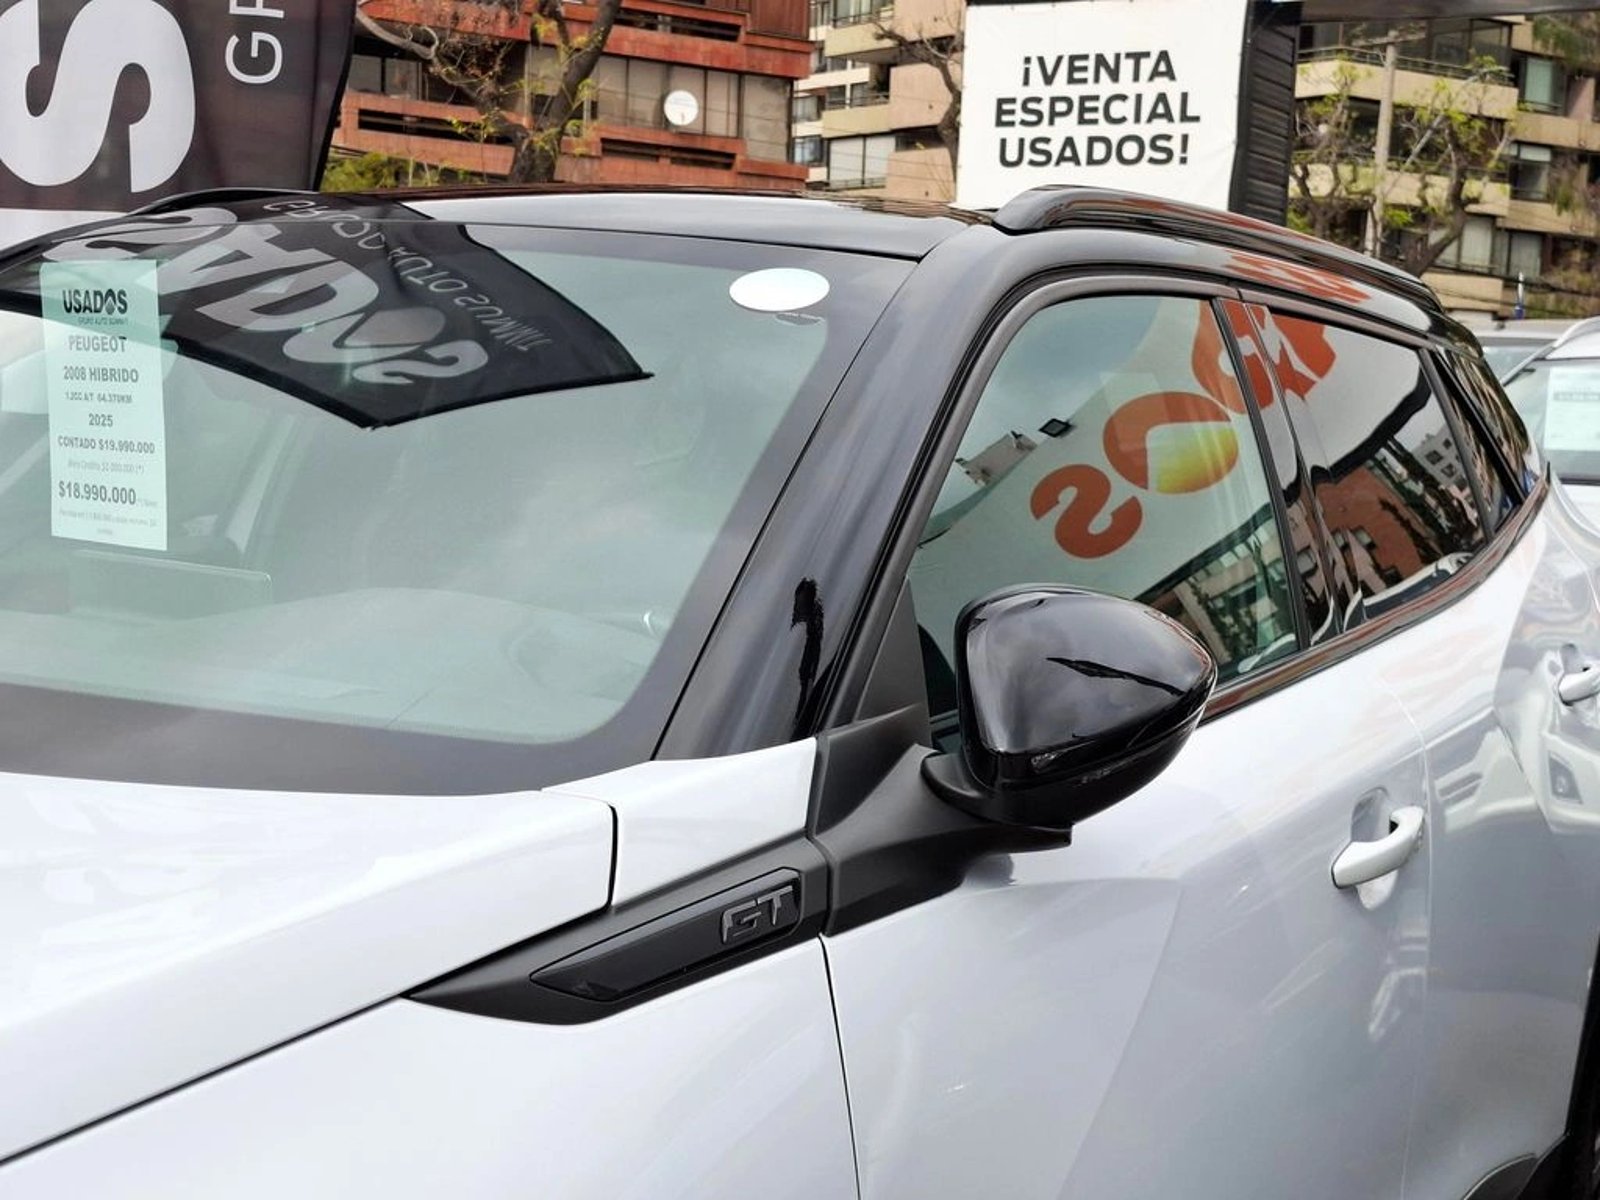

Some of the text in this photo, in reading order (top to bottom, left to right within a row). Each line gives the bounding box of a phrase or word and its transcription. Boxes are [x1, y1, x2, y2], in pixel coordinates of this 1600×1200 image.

[1022, 50, 1177, 87] ¡VENTA
[995, 92, 1201, 128] ESPECIAL
[999, 133, 1190, 168] USADOS!
[62, 289, 128, 315] USADOS
[68, 335, 127, 353] PEUGEOT
[63, 366, 139, 383] 2008 HIBRIDO
[88, 413, 114, 428] 2025
[58, 435, 156, 454] CONTADO $19.990.000
[58, 480, 137, 506] $18.990.000
[721, 883, 795, 944] GT
